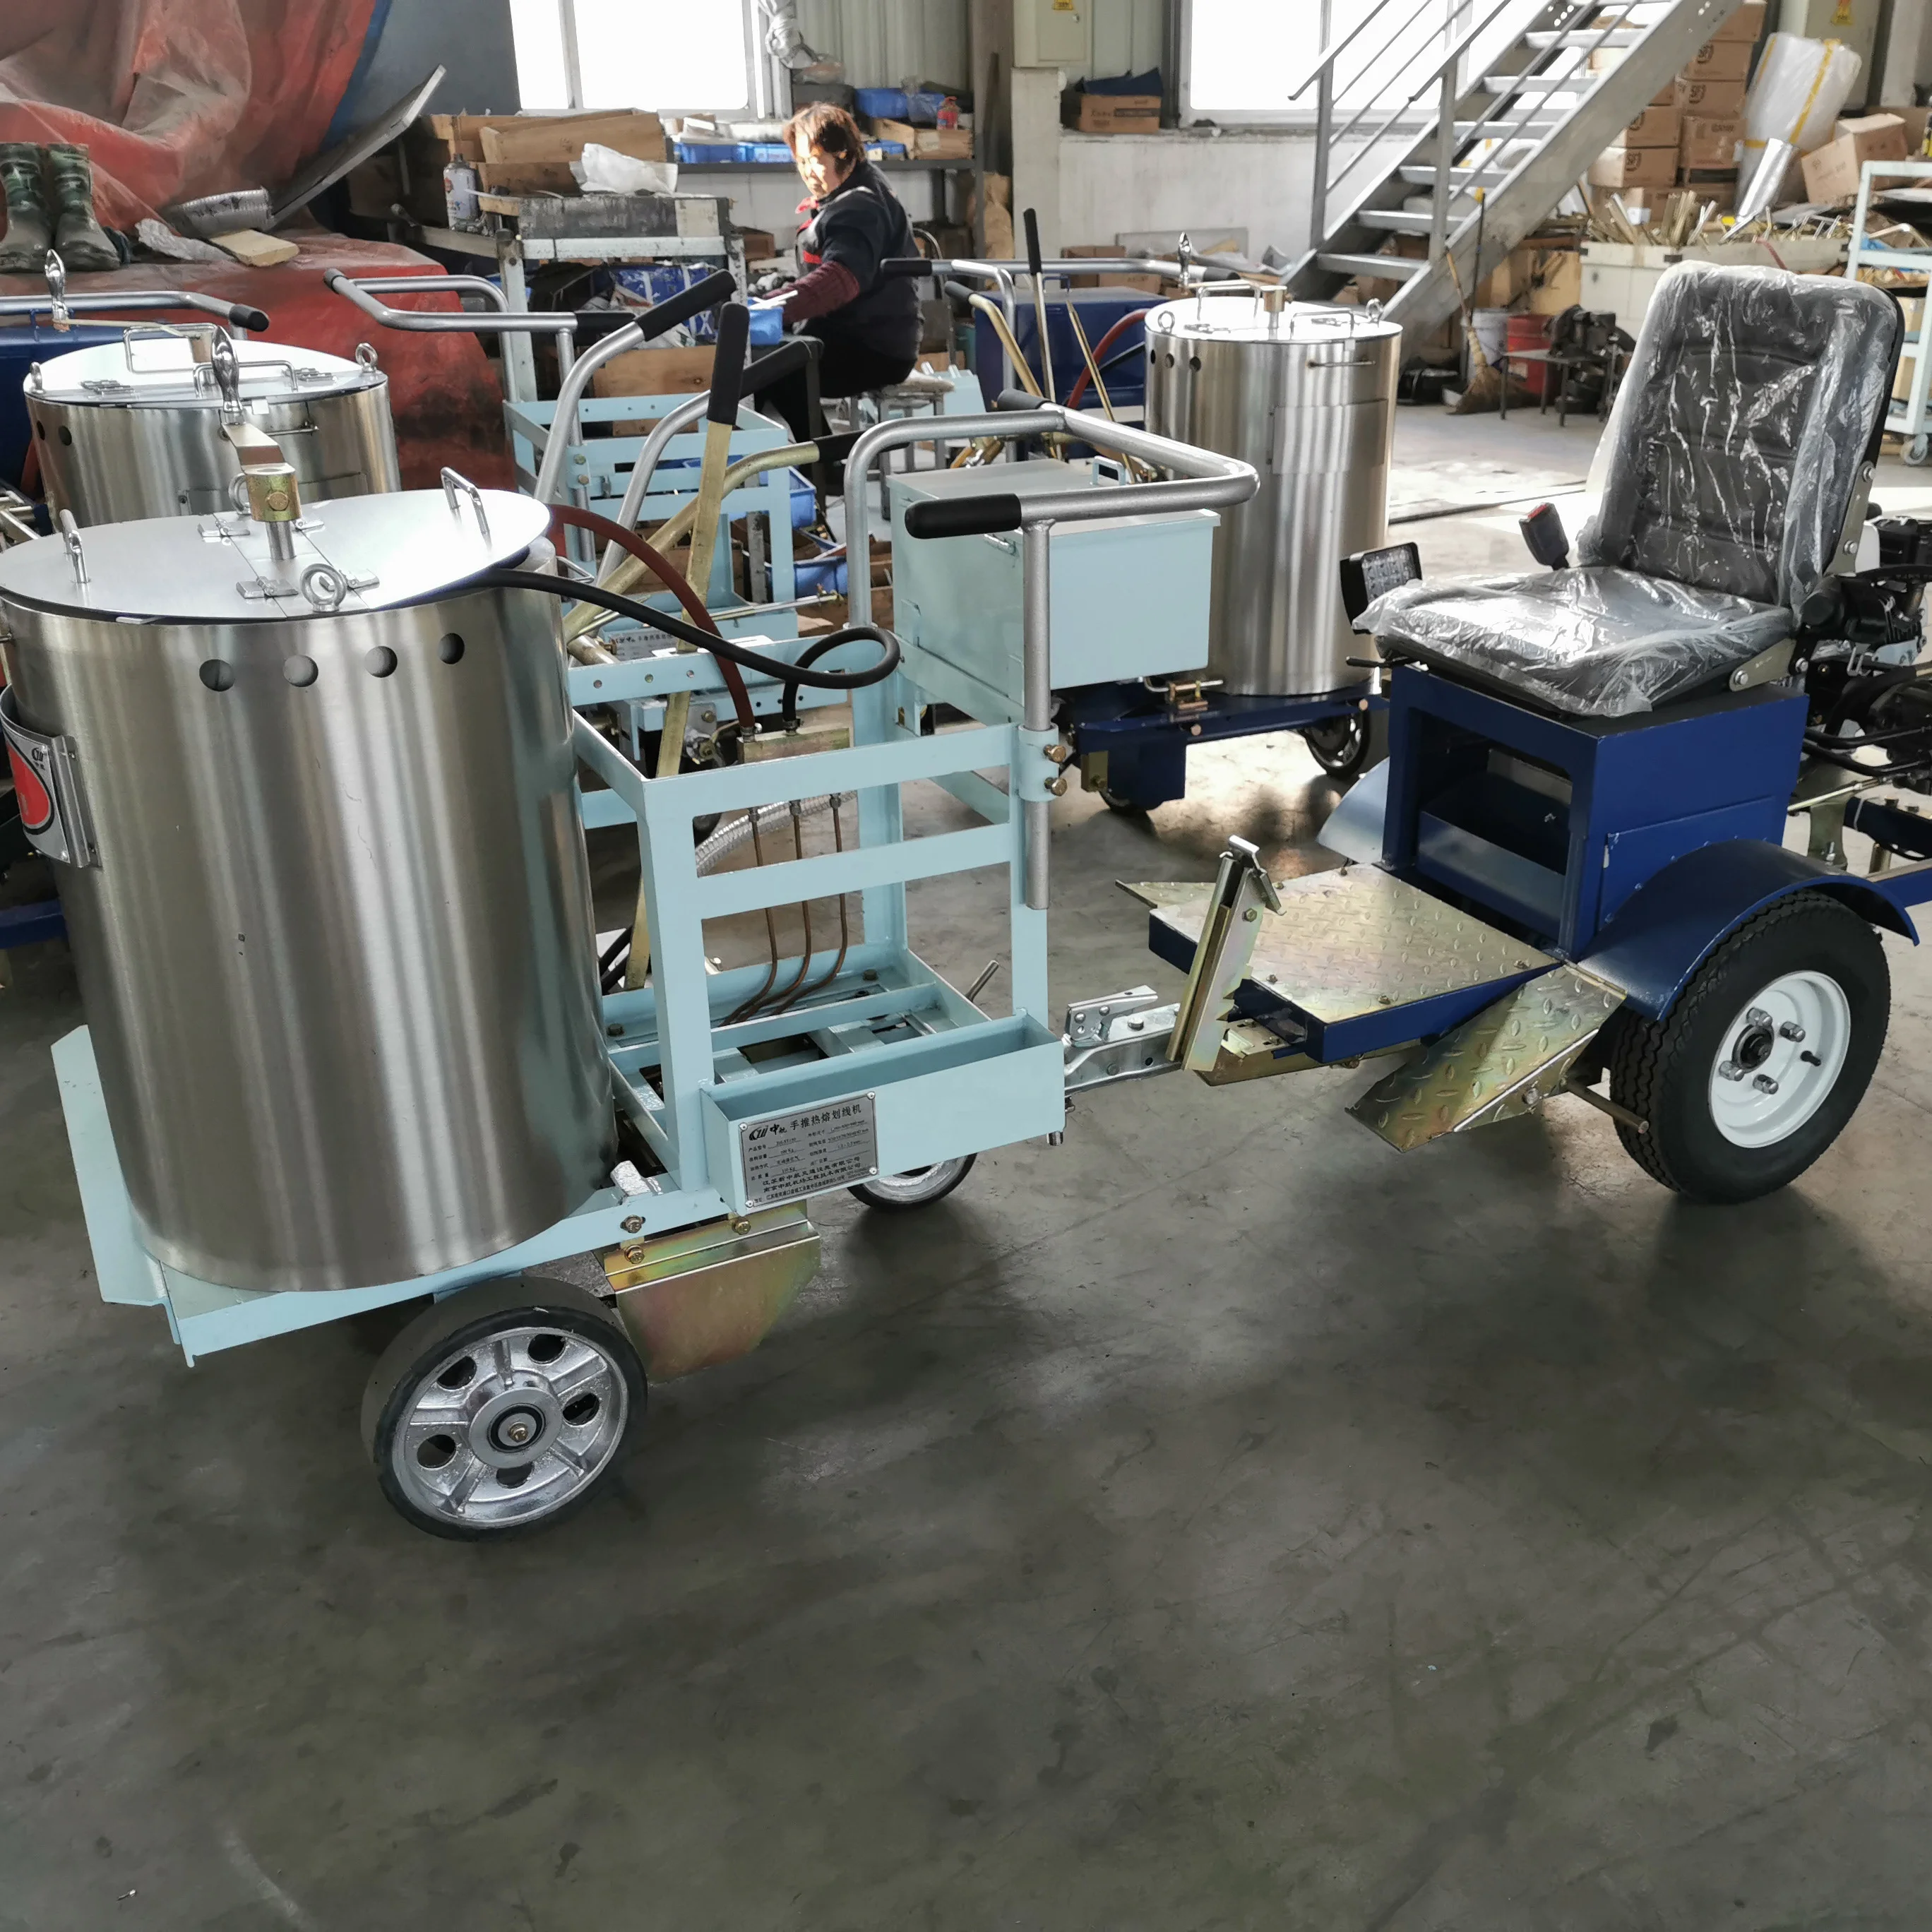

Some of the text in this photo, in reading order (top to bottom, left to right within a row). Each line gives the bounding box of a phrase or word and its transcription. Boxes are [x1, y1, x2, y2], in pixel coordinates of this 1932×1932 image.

[790, 1104, 861, 1130] 手推热熔划线机
